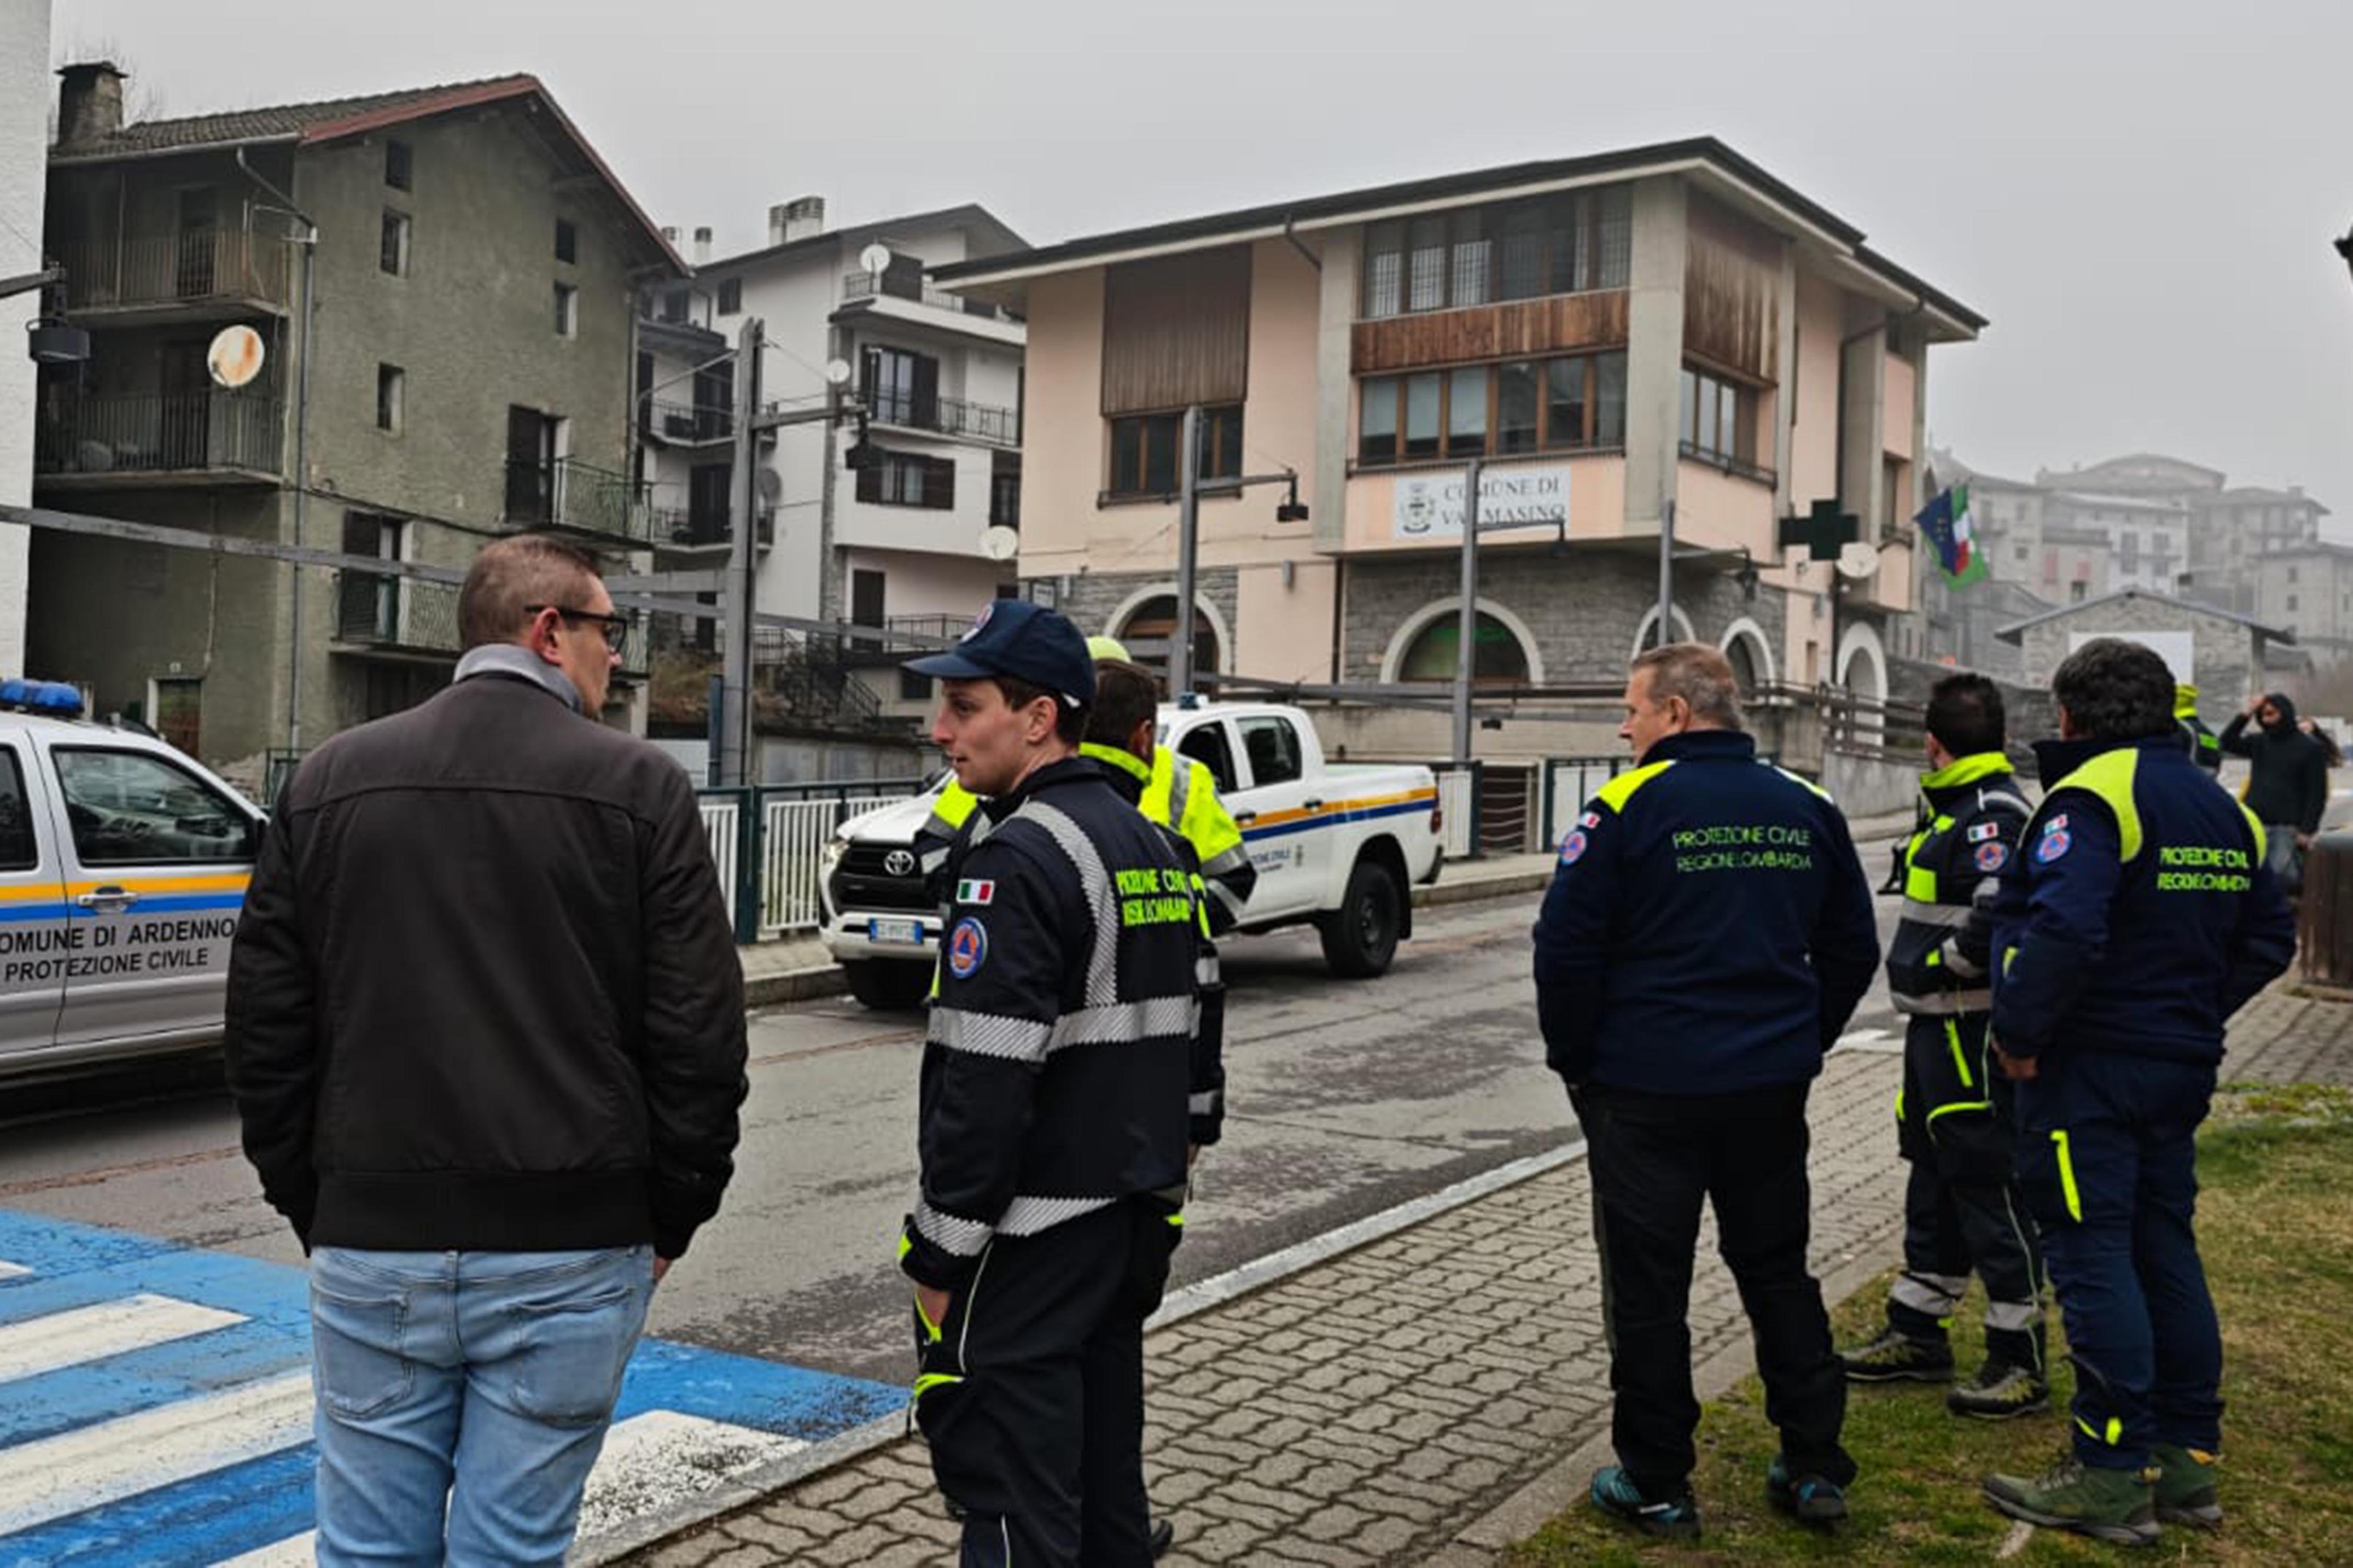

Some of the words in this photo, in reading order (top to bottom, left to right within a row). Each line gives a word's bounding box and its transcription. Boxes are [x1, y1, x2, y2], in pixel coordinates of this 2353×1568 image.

[1539, 477, 1558, 495] DI
[1485, 504, 1565, 525] MASINO
[1672, 826, 1764, 848] PROTEZIONE
[1768, 825, 1811, 846] CIVILE
[0, 928, 84, 954] OMUNE
[95, 926, 116, 947] DI
[128, 918, 235, 945] ARDENNO
[5, 953, 141, 982] PROTEZIONE
[148, 948, 208, 969] CIVILE
